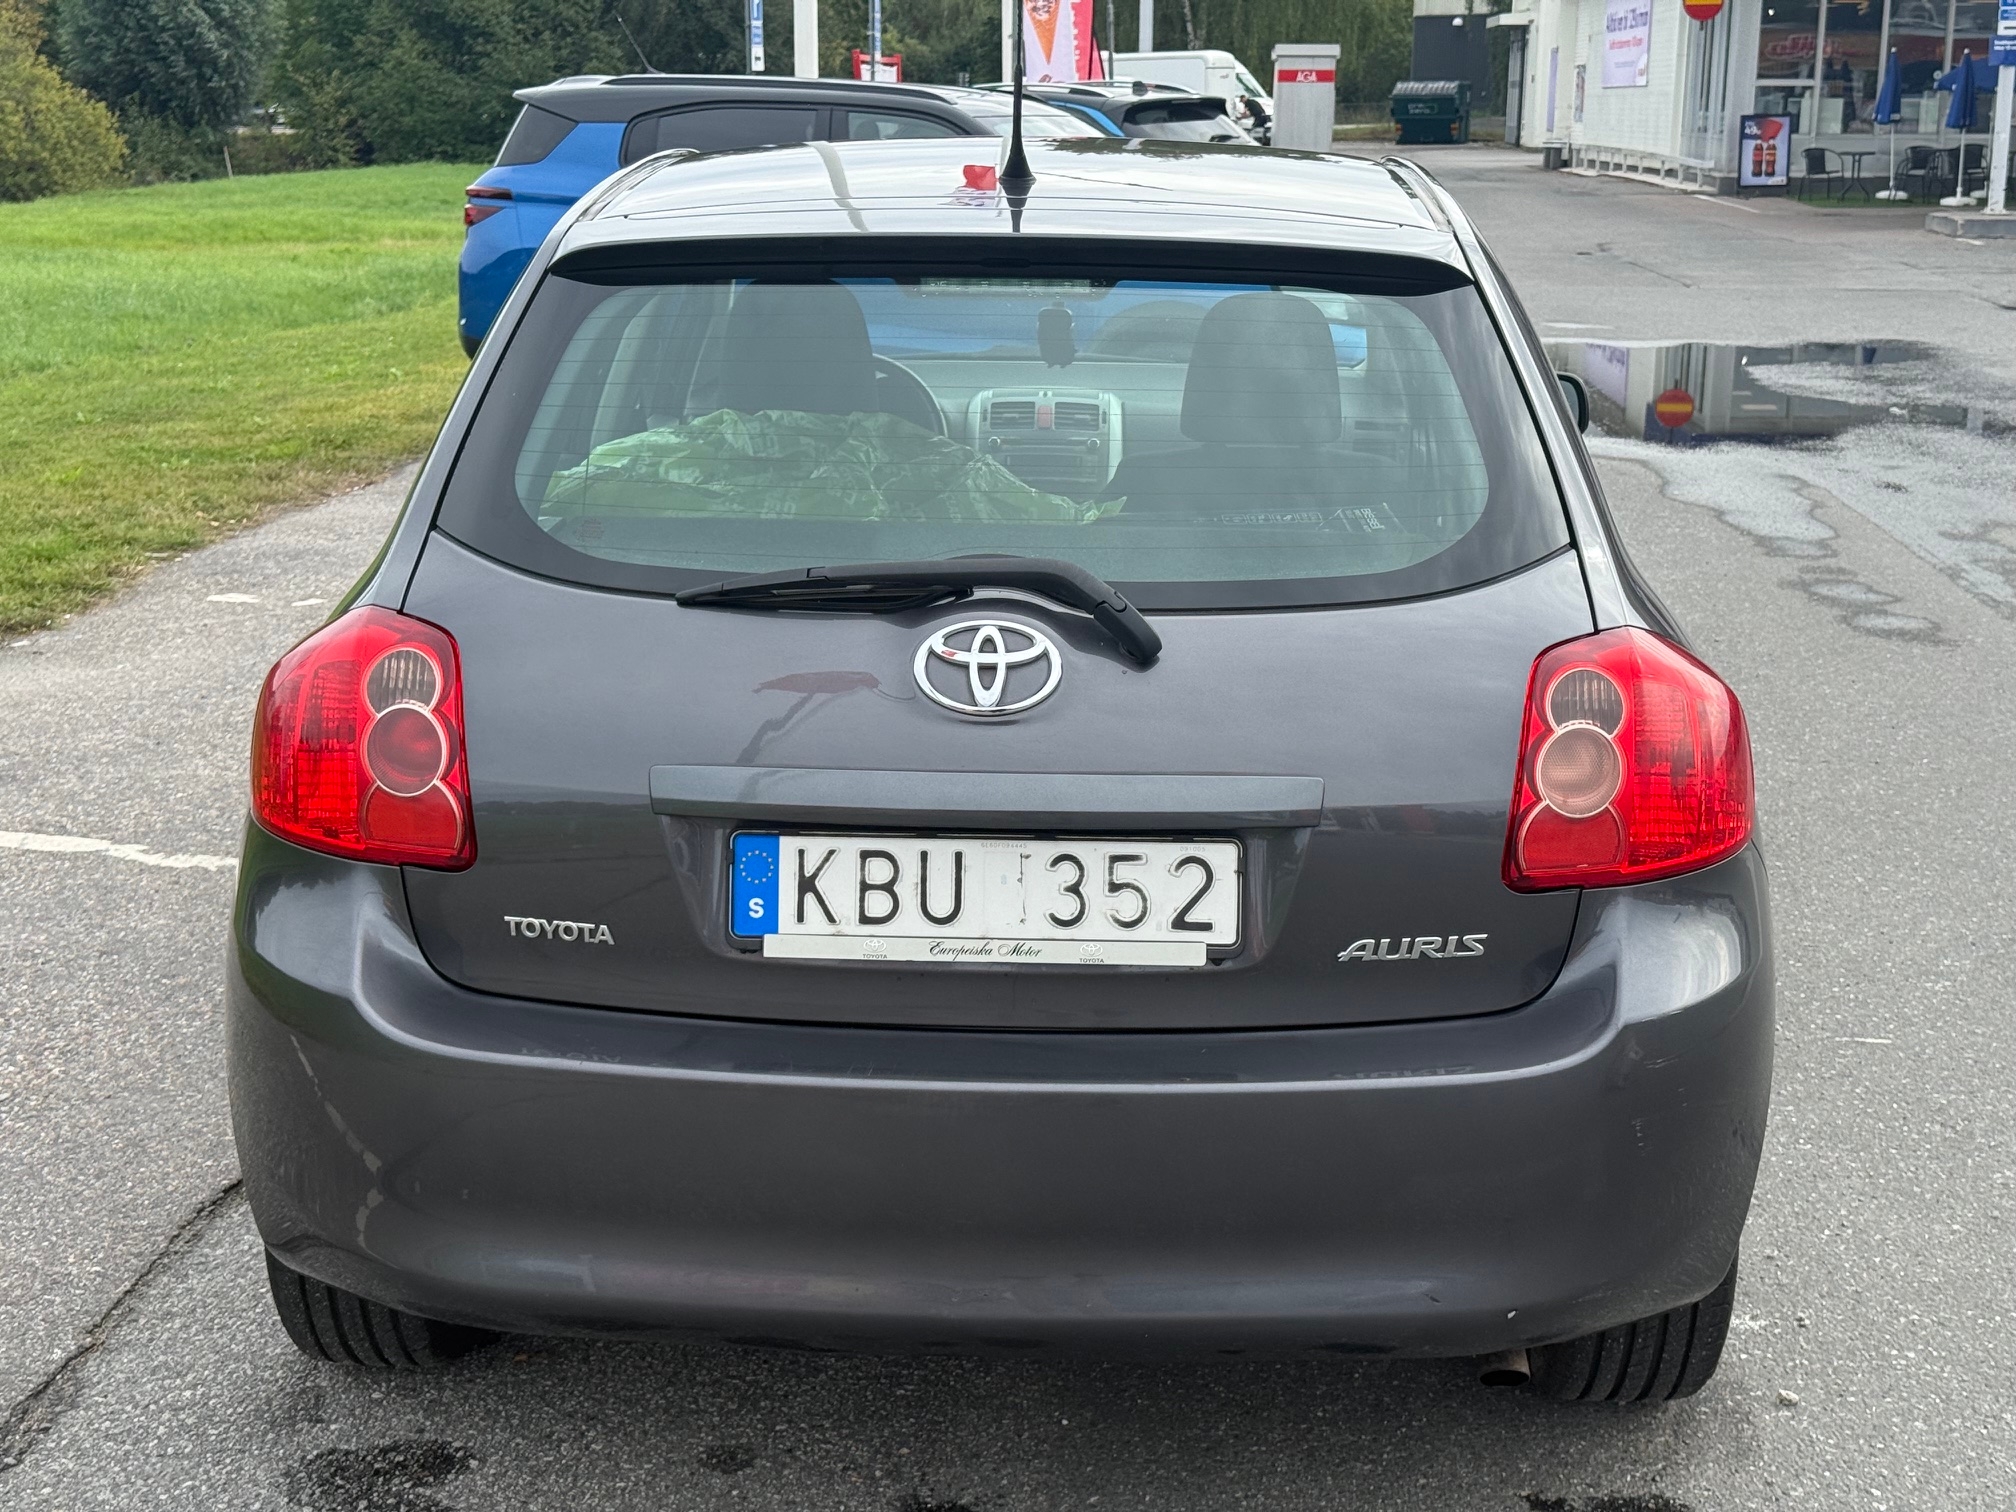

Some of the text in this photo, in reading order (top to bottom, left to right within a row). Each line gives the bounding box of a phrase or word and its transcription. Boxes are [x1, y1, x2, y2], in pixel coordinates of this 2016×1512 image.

[1296, 71, 1317, 82] AGA
[796, 848, 1215, 930] KBU 352
[749, 898, 764, 918] S
[503, 915, 615, 945] TOYOTA
[929, 941, 1043, 962] Europeiska Motor
[1336, 933, 1489, 962] AURIS
